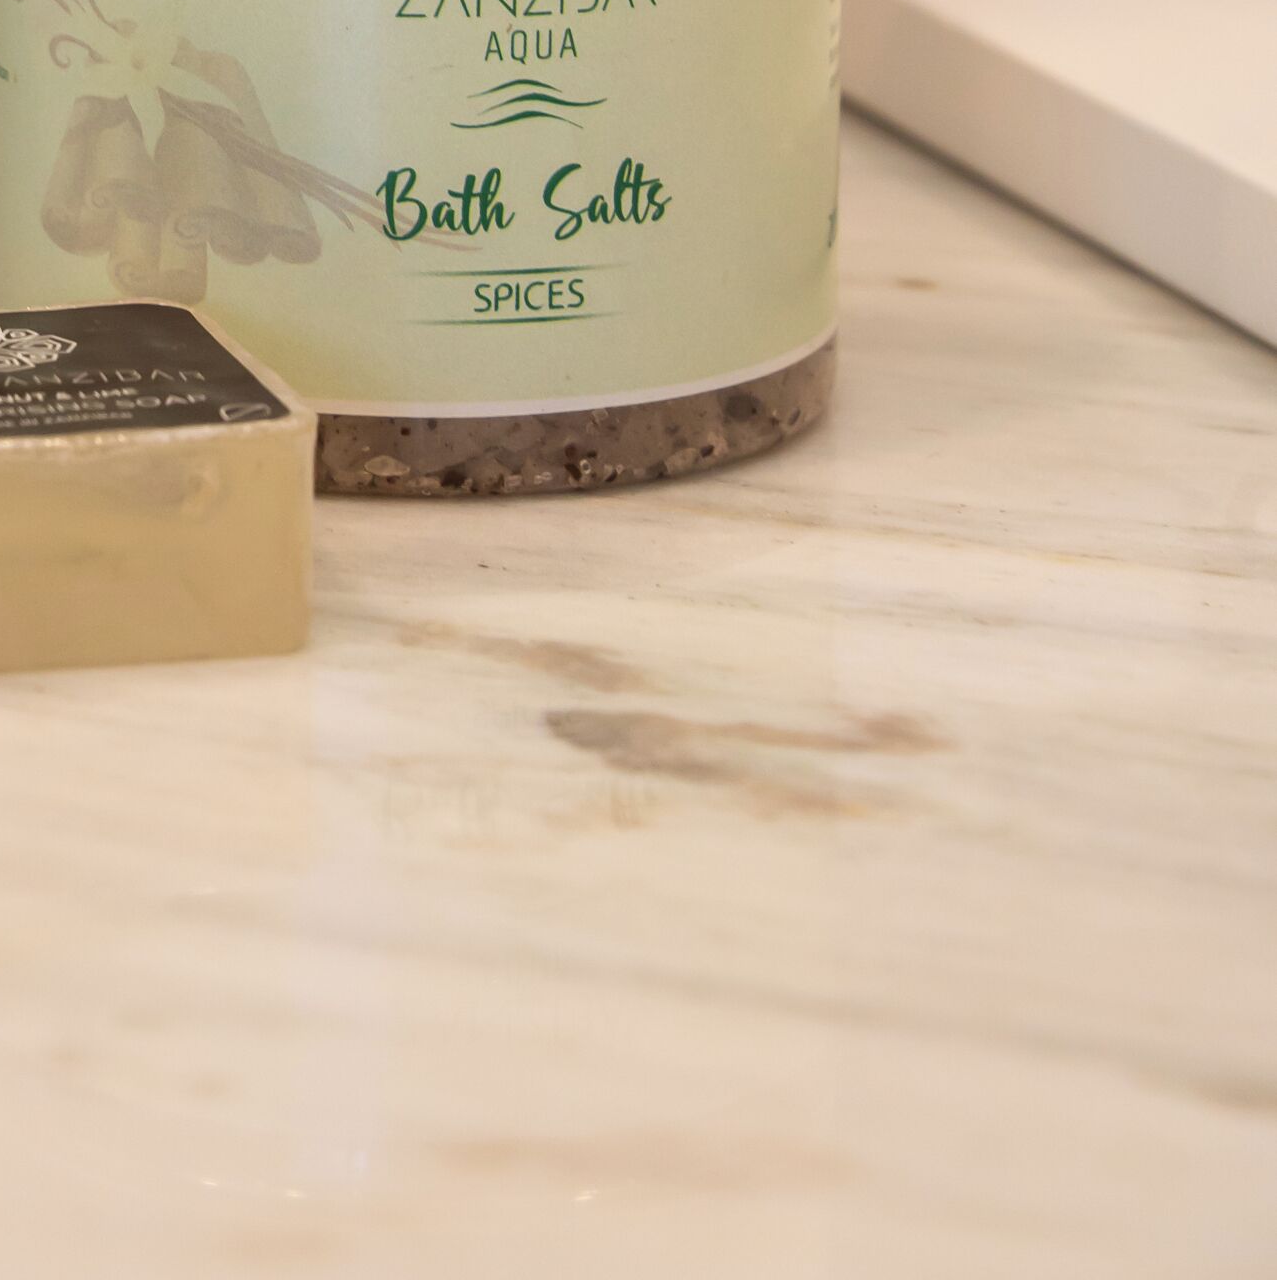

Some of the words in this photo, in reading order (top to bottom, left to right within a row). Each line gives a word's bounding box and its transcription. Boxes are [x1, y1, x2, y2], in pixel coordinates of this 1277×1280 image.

[483, 27, 579, 66] AQUA
[376, 167, 515, 242] Bath
[542, 157, 673, 241] Salts
[473, 278, 586, 314] SPICES
